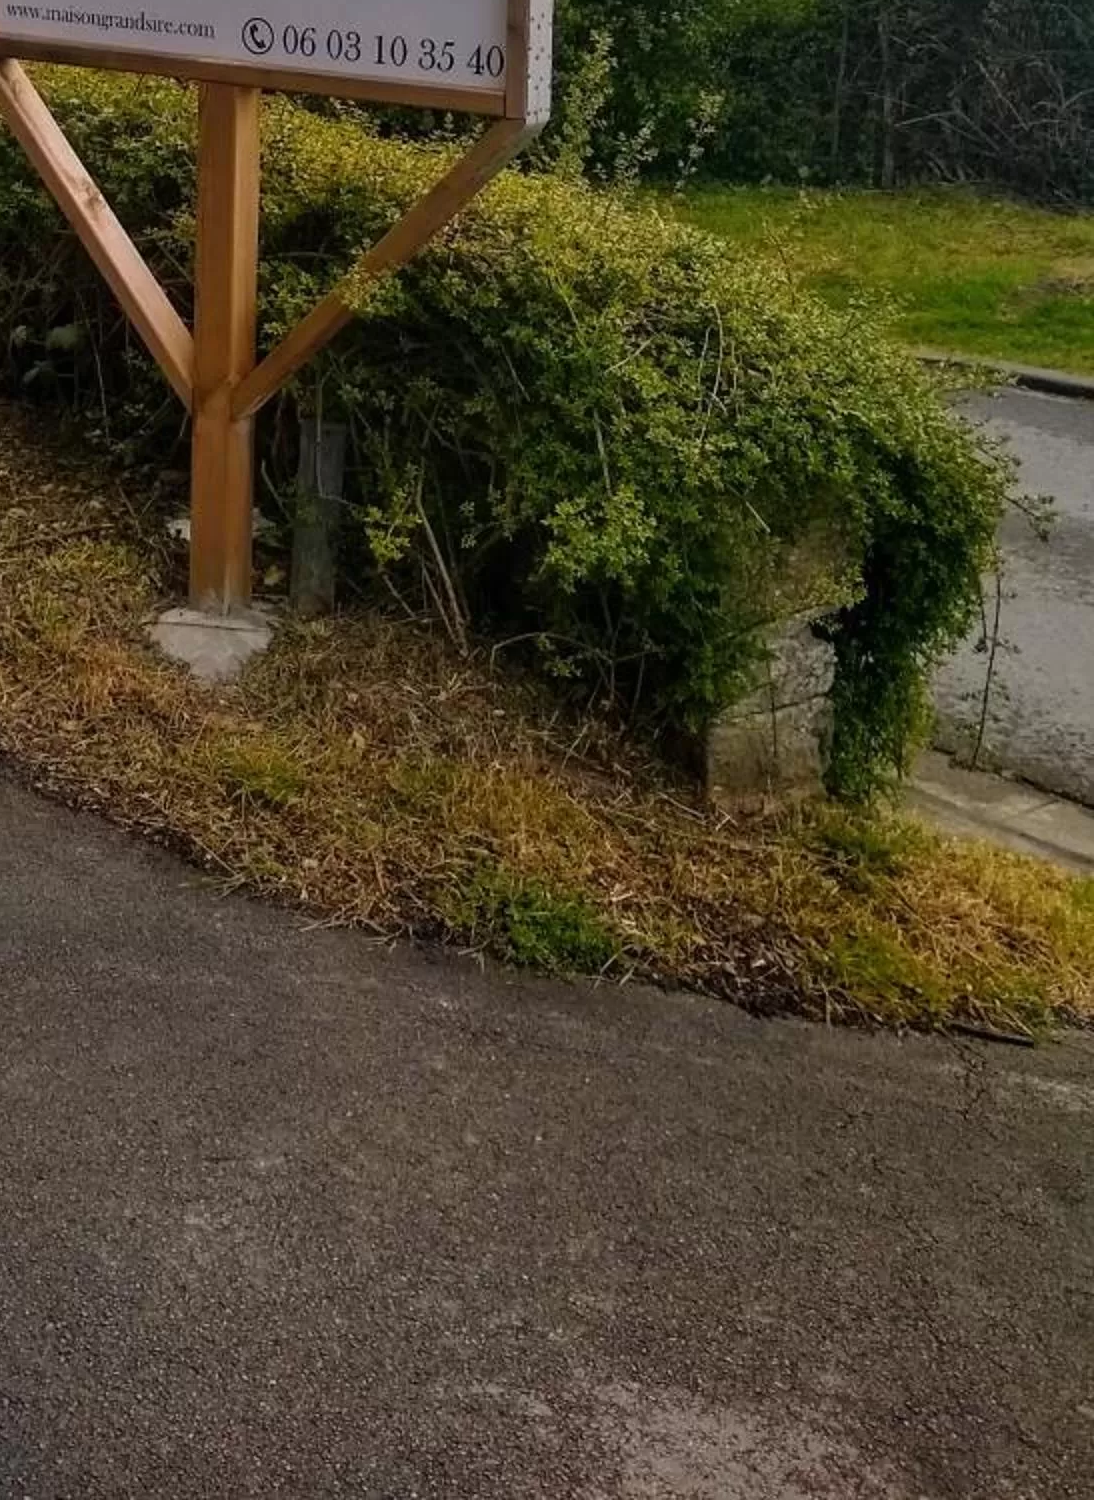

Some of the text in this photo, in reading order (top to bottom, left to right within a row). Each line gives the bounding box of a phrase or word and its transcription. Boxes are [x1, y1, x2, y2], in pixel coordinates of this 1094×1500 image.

[7, 3, 216, 39] www.maisongrandsire.com
[282, 25, 505, 77] 06 03 10 35 40
